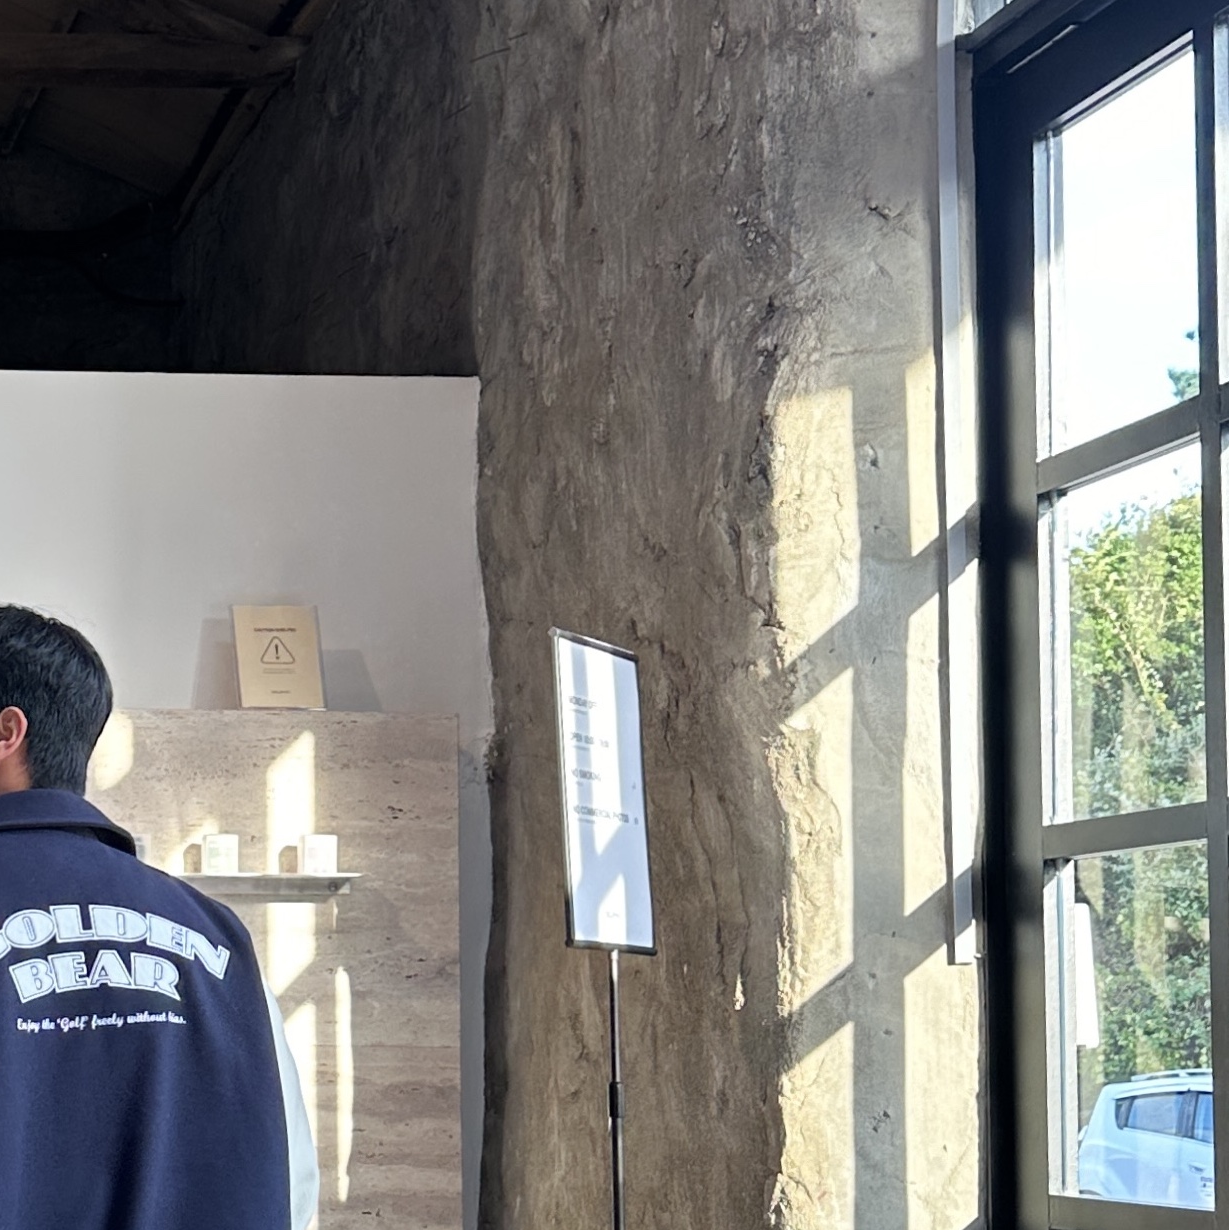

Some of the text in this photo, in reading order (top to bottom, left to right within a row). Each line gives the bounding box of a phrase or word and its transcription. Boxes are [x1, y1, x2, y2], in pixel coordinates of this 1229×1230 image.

[9, 950, 181, 1003] BEAR
[17, 1018, 40, 1033] Enjoy
[42, 1018, 55, 1030] the
[91, 1013, 124, 1030] freely
[127, 1011, 167, 1024] without
